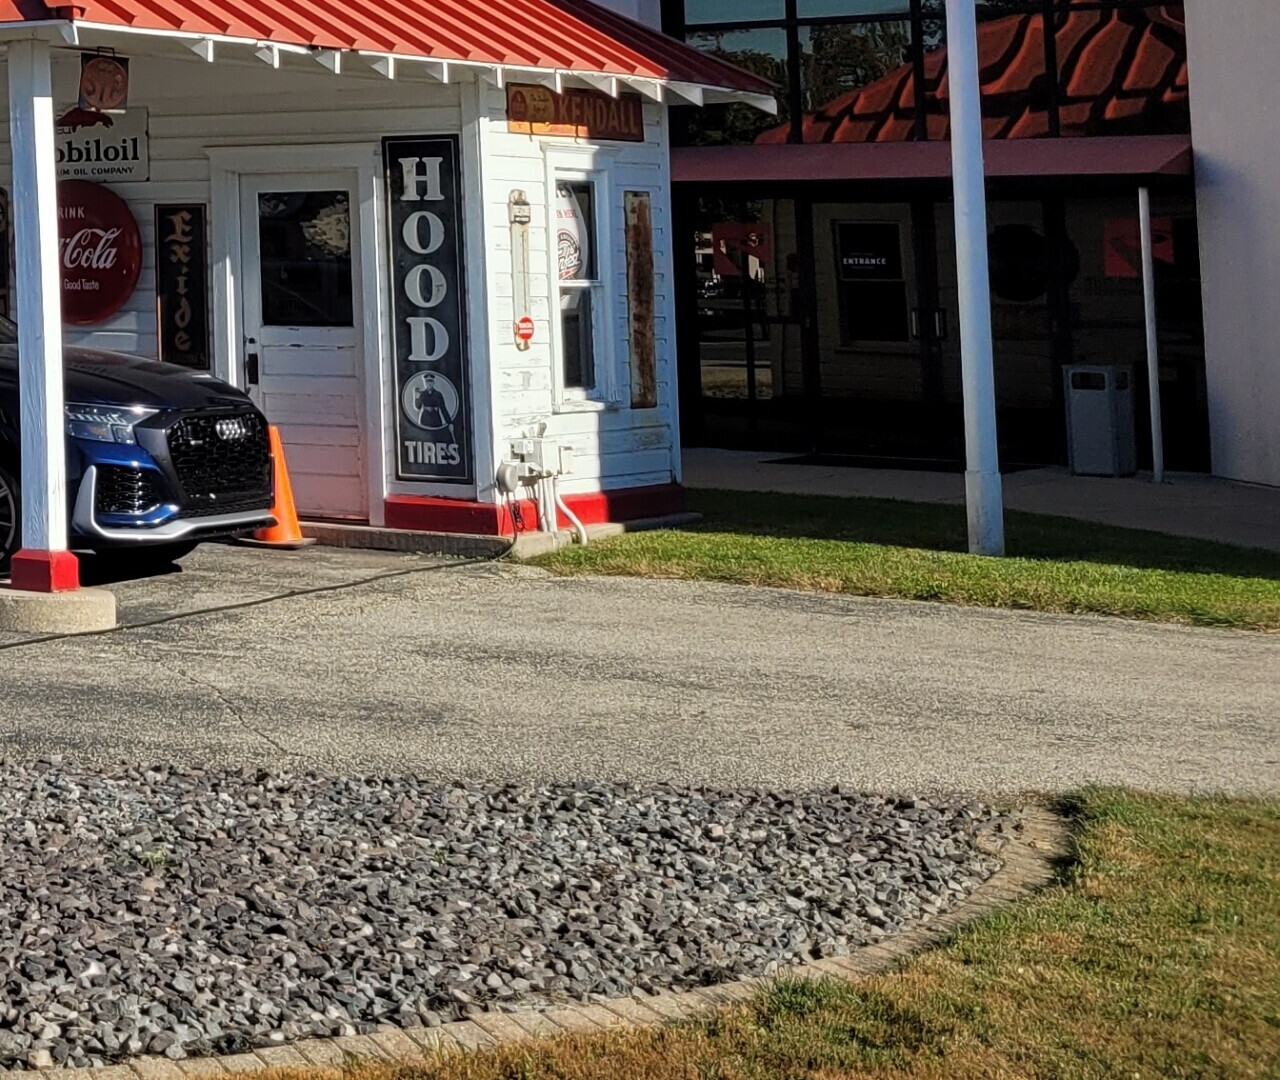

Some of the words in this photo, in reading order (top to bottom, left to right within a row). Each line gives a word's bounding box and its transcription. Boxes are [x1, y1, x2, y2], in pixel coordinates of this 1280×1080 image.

[558, 94, 641, 134] KENDALL
[56, 137, 140, 163] obiloil
[74, 168, 88, 176] OIL
[91, 166, 134, 175] COMPANY
[57, 206, 85, 219] RINK
[397, 156, 450, 362] HOOD
[64, 278, 81, 290] Good
[81, 278, 99, 290] Taste
[164, 210, 193, 351] Exide
[404, 440, 460, 465] TIRES
